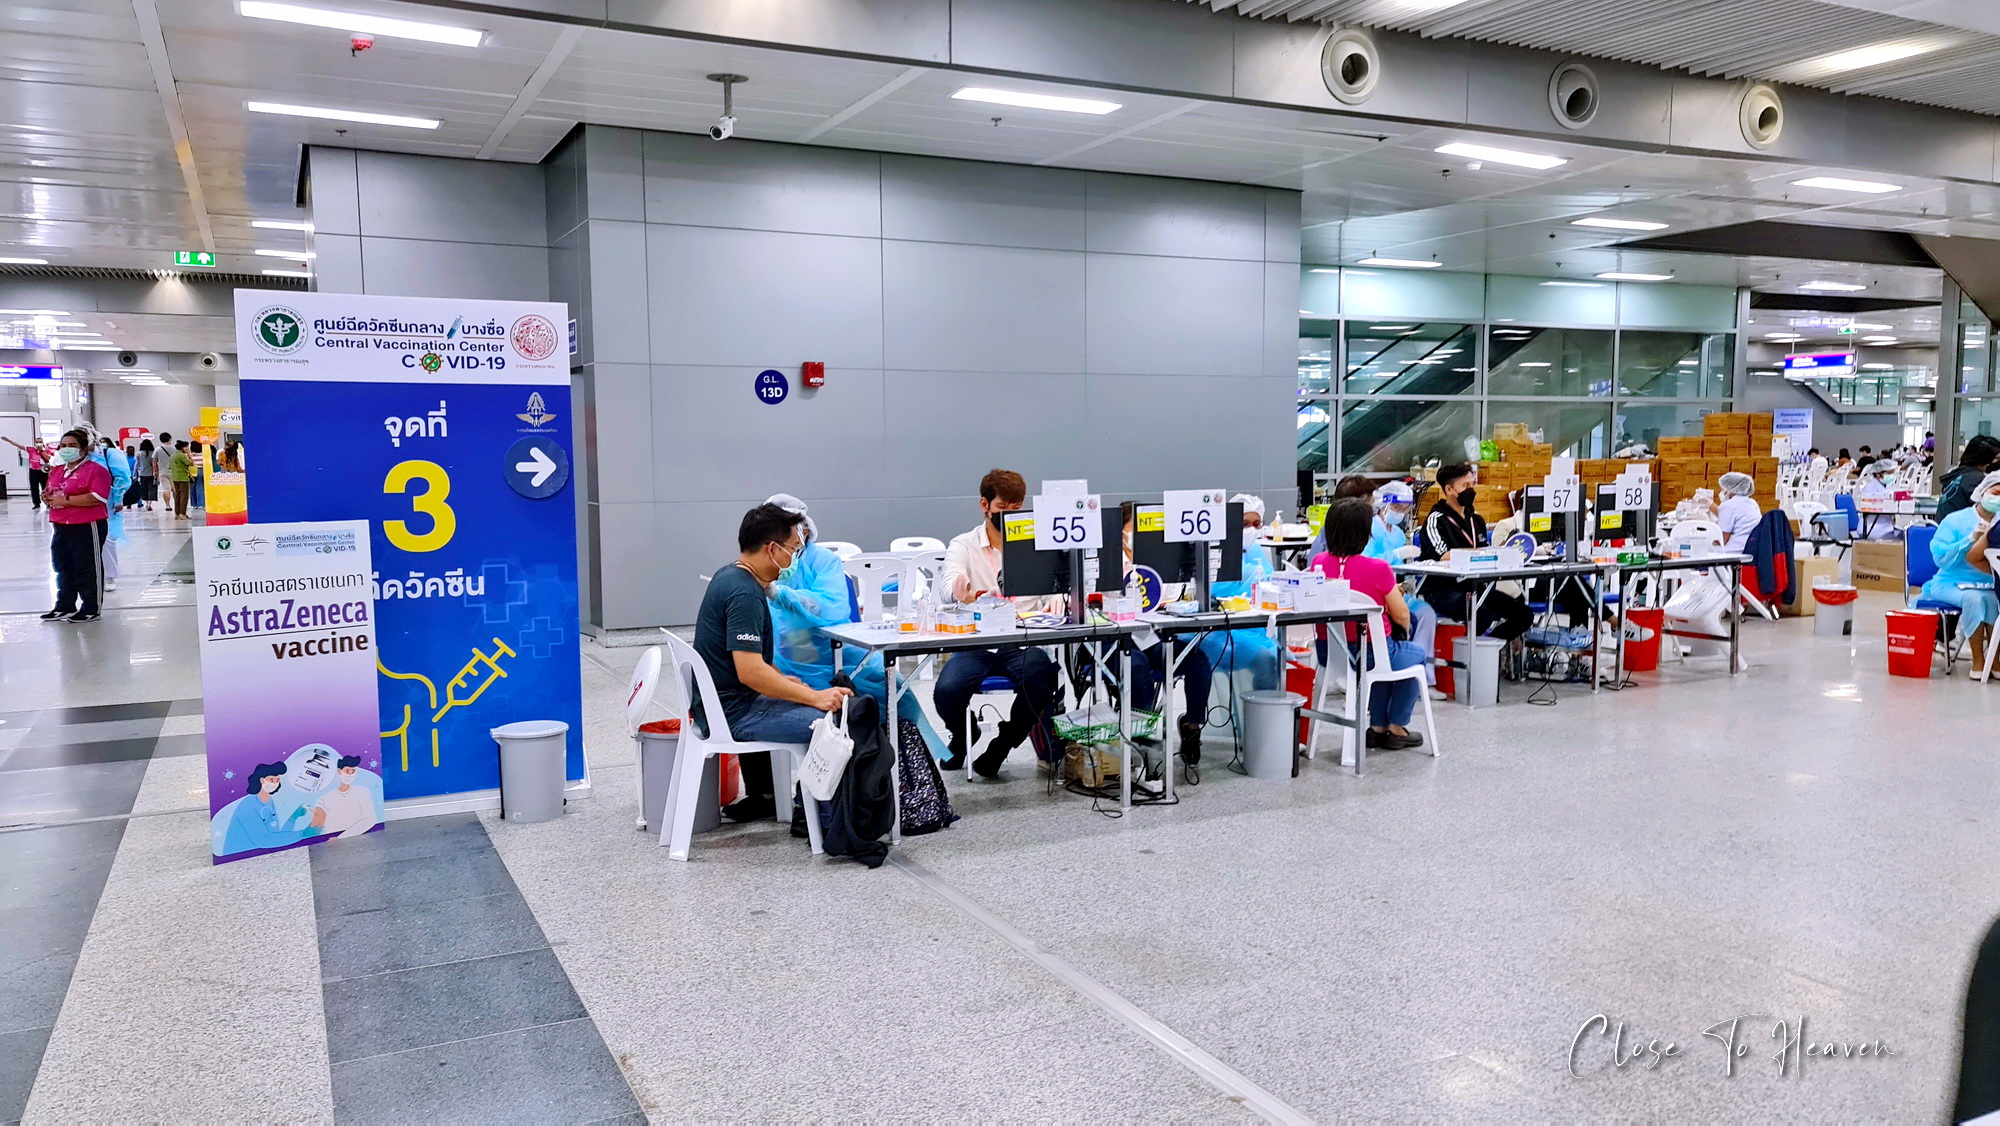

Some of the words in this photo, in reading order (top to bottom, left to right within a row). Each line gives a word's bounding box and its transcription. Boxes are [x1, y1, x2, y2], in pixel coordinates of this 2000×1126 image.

[313, 316, 445, 335] ศูนย์ฉีดวัคซีนกลาง
[461, 318, 505, 336] บางซื่อ
[314, 336, 369, 350] Central
[373, 337, 455, 352] Vaccination
[459, 340, 505, 353] Center
[763, 375, 779, 384] G.L.
[761, 386, 783, 398] 13D
[384, 399, 448, 448] จุดที่
[383, 459, 457, 553] 3
[1553, 489, 1571, 508] 57
[1624, 487, 1643, 506] 58
[1007, 525, 1022, 535] NT
[1052, 516, 1086, 544] 55
[1139, 517, 1152, 526] NT
[1180, 509, 1211, 535] 56
[208, 573, 364, 598] วัคซีนแอสตราเซเนกา
[208, 599, 368, 636] AstraZeneca
[272, 631, 369, 660] vaccine
[736, 633, 761, 642] adidas
